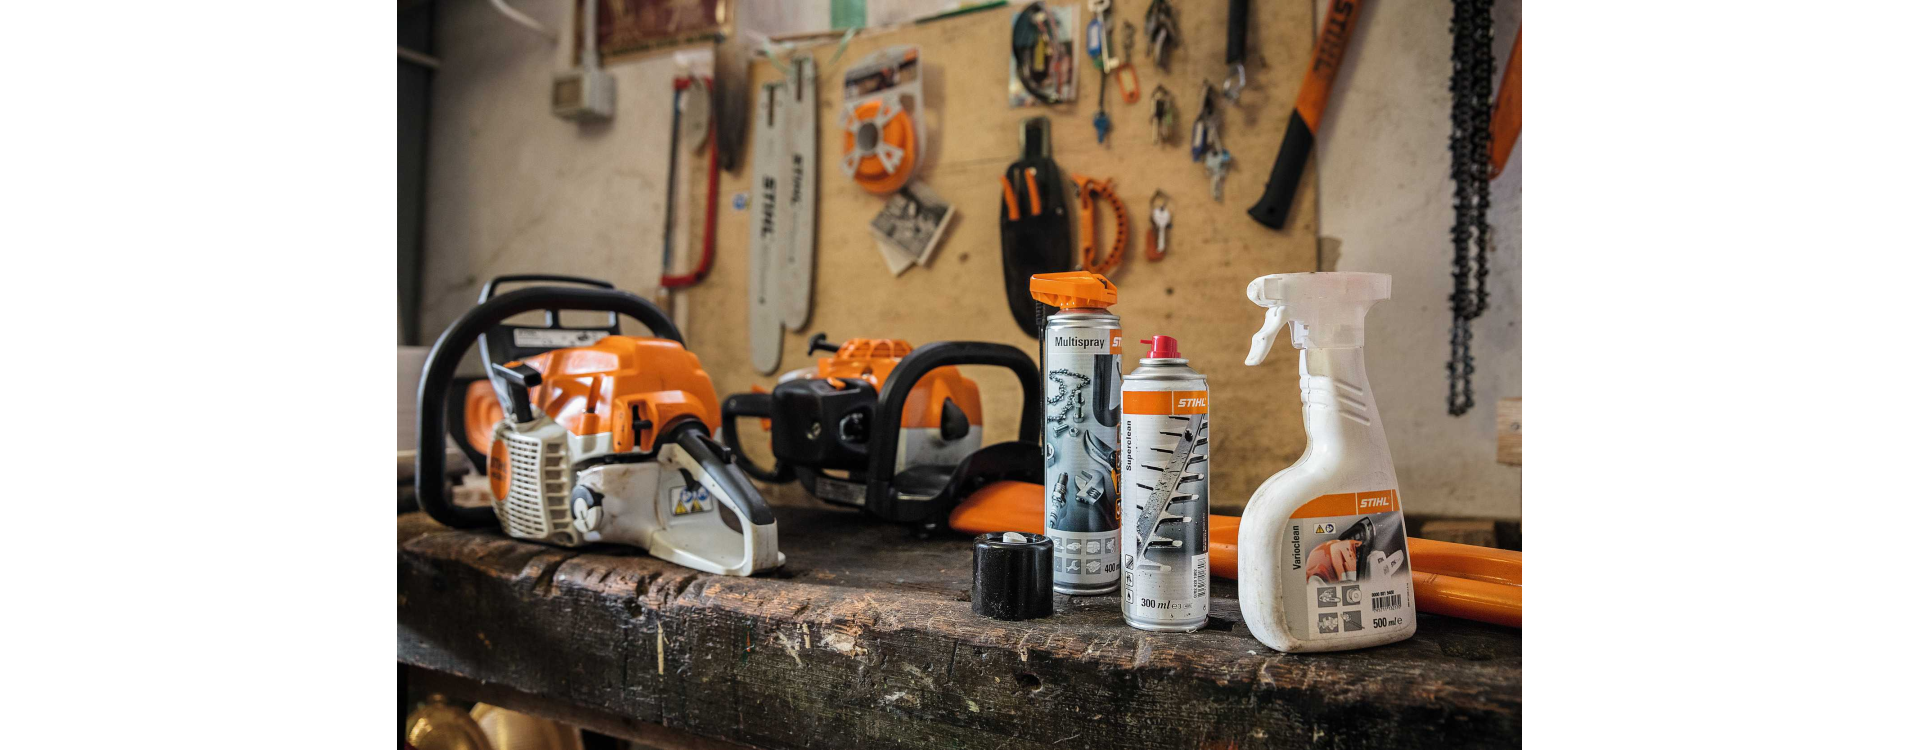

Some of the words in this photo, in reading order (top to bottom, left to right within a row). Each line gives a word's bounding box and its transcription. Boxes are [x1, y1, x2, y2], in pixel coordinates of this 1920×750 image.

[1313, 0, 1354, 72] STIHL
[761, 176, 776, 237] STIHL
[1054, 336, 1105, 349] Multispray
[1178, 397, 1206, 408] STIHL
[1360, 496, 1390, 508] STIHL
[1291, 525, 1302, 571] Varioclean
[1104, 563, 1116, 574] 400
[1141, 598, 1156, 609] 300
[1157, 600, 1171, 610] ml
[1373, 617, 1387, 629] 500
[1388, 617, 1397, 627] ml
